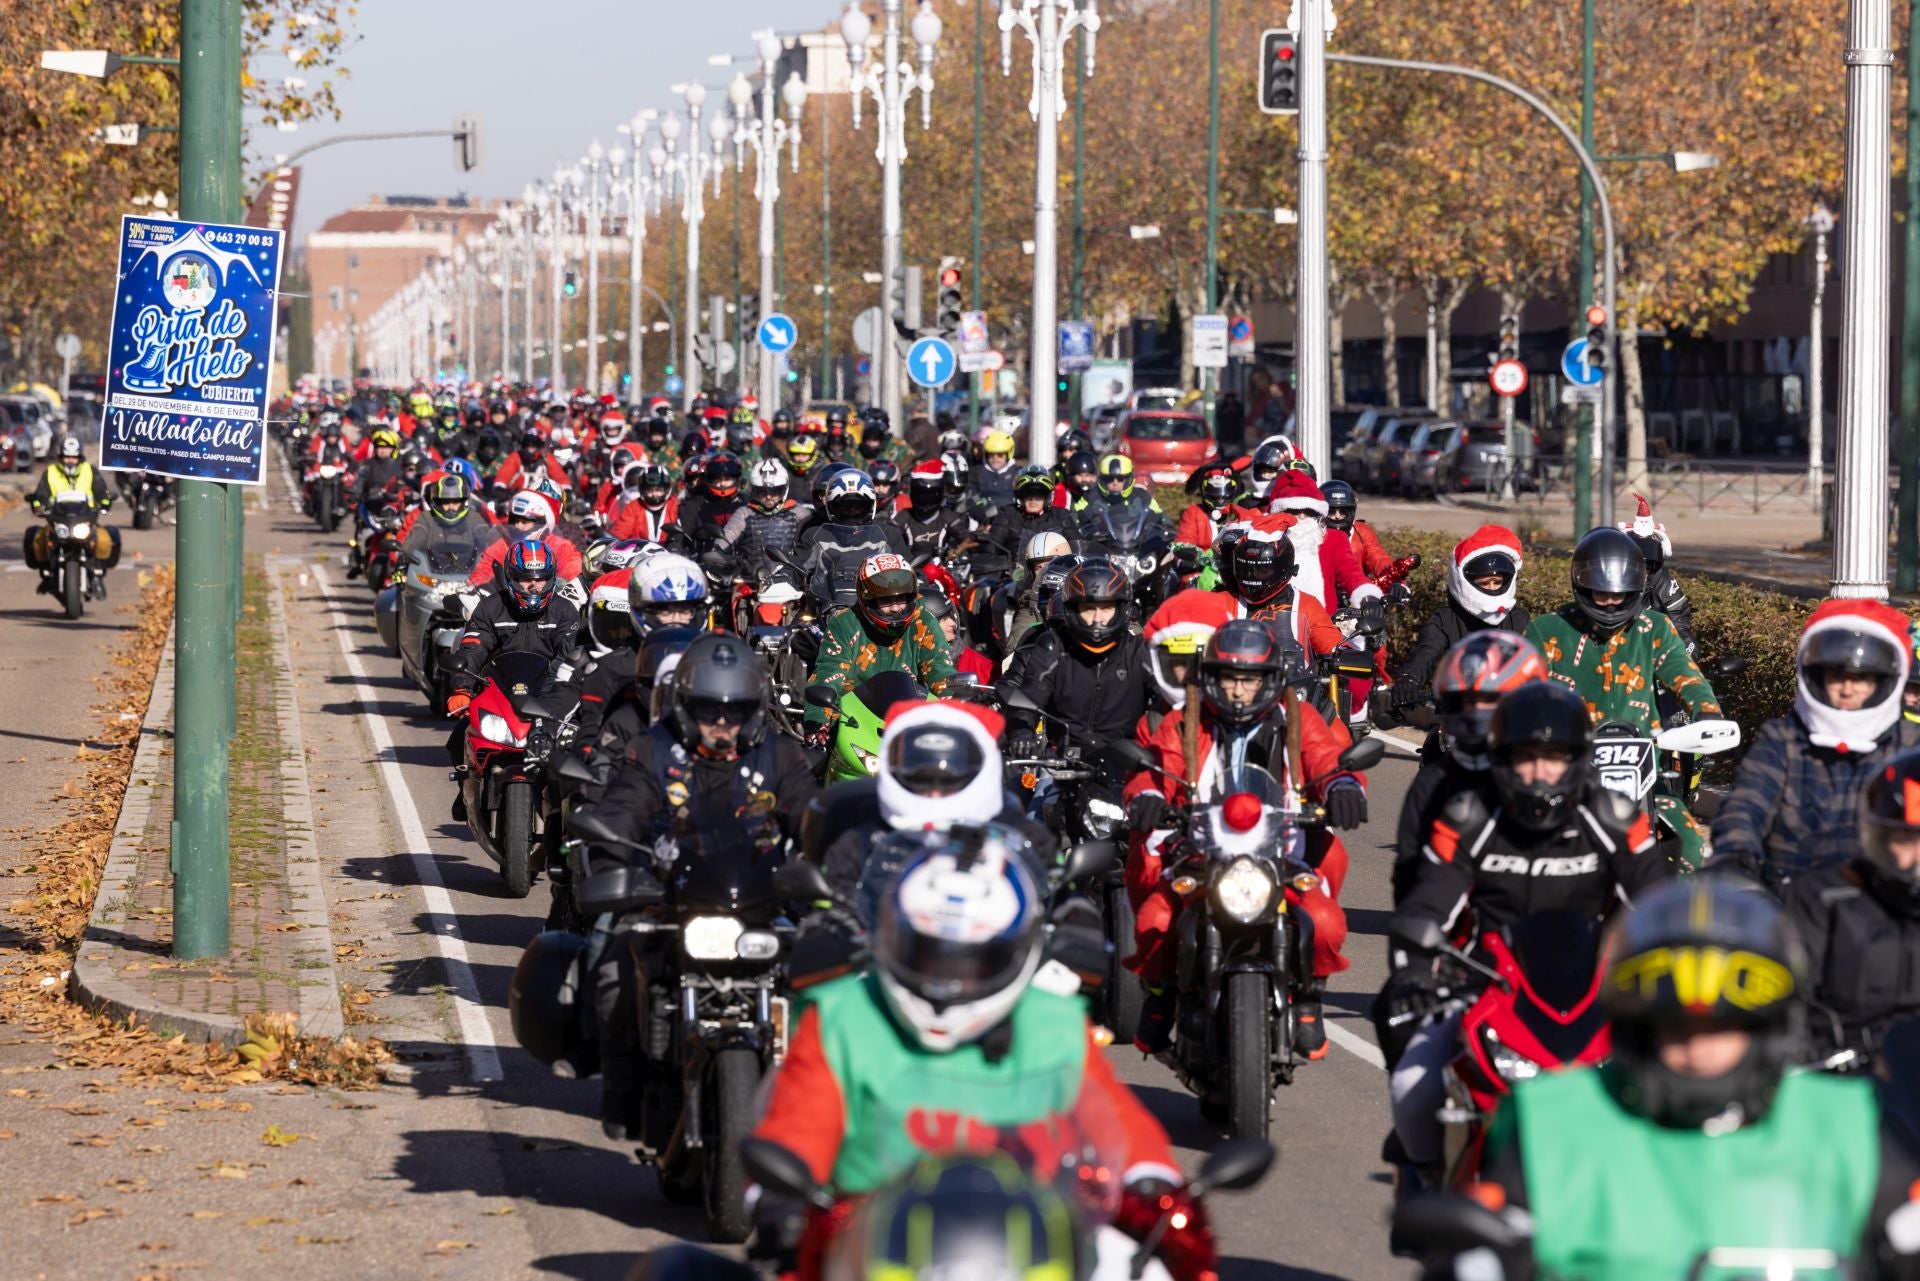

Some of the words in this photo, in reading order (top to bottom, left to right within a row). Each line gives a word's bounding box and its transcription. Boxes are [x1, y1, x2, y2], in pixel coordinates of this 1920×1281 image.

[129, 222, 145, 239] 50%
[150, 232, 155, 240] Y
[154, 233, 174, 242] AMPA
[151, 225, 175, 234] COLEGIOS
[216, 232, 233, 243] 663
[235, 233, 247, 244] 29
[248, 234, 260, 246] 00
[262, 236, 273, 247] 83
[133, 306, 204, 352] Pista
[209, 300, 245, 338] de
[167, 336, 251, 385] Hielo
[201, 384, 255, 403] CUBIERTA
[114, 396, 126, 405] DEL
[129, 398, 136, 406] 29
[137, 399, 147, 407] DE
[149, 400, 192, 412] NOVIEMBRE
[194, 405, 204, 413] AL
[214, 407, 225, 415] DE
[227, 408, 256, 417] ENERO
[112, 410, 253, 450] Valladolid
[110, 443, 129, 451] ACERA
[138, 446, 166, 455] RECOLETOS
[171, 450, 188, 458] PASEO
[202, 453, 225, 461] CAMPO
[225, 455, 252, 463] GRANDE
[1595, 745, 1640, 765] 314
